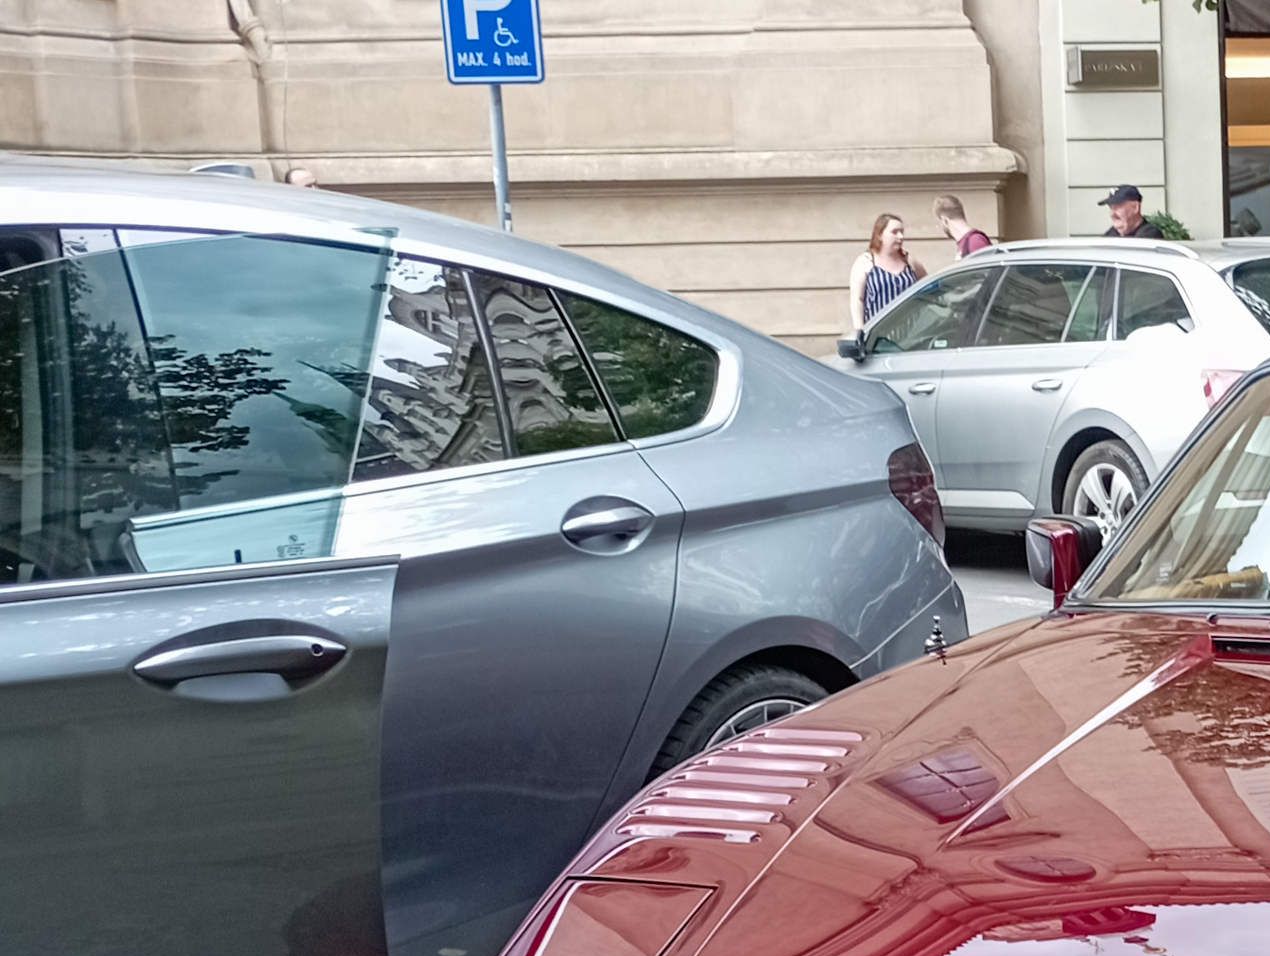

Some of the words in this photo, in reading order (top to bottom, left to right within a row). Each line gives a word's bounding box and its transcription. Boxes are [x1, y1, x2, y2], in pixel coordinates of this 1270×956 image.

[457, 52, 488, 66] MAX.
[493, 52, 501, 66] 4
[506, 52, 532, 66] hod.
